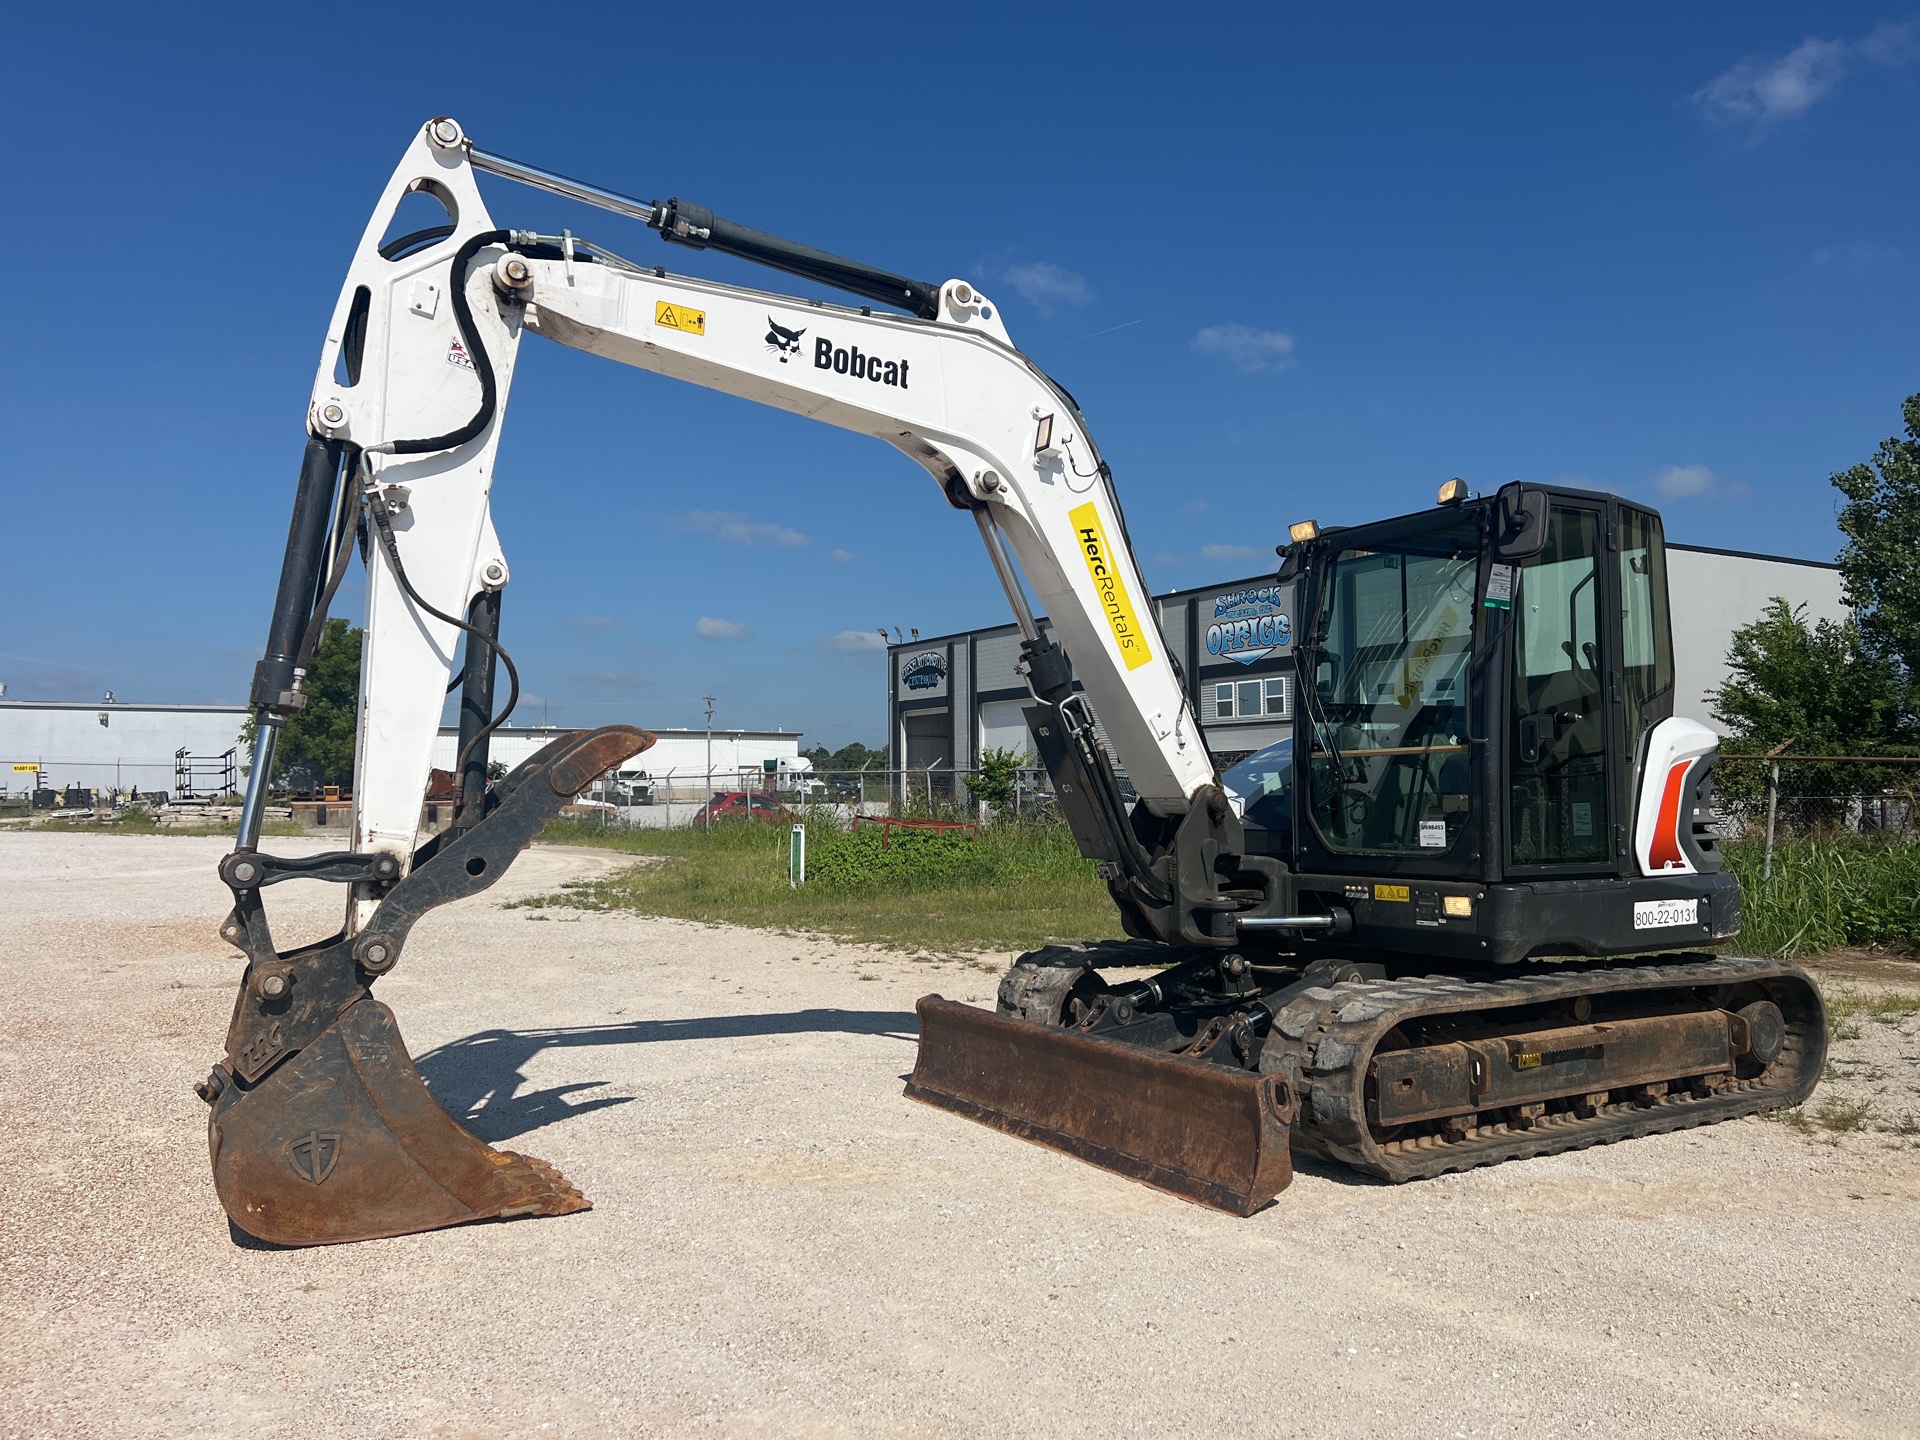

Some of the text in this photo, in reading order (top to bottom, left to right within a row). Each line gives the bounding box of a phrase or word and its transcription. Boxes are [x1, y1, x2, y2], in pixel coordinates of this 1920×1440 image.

[448, 354, 476, 370] USA
[814, 337, 909, 389] Bobcat
[1214, 584, 1282, 618] SHROCK
[1206, 614, 1292, 655] OFFICE
[1635, 908, 1697, 927] 800-22-0131
